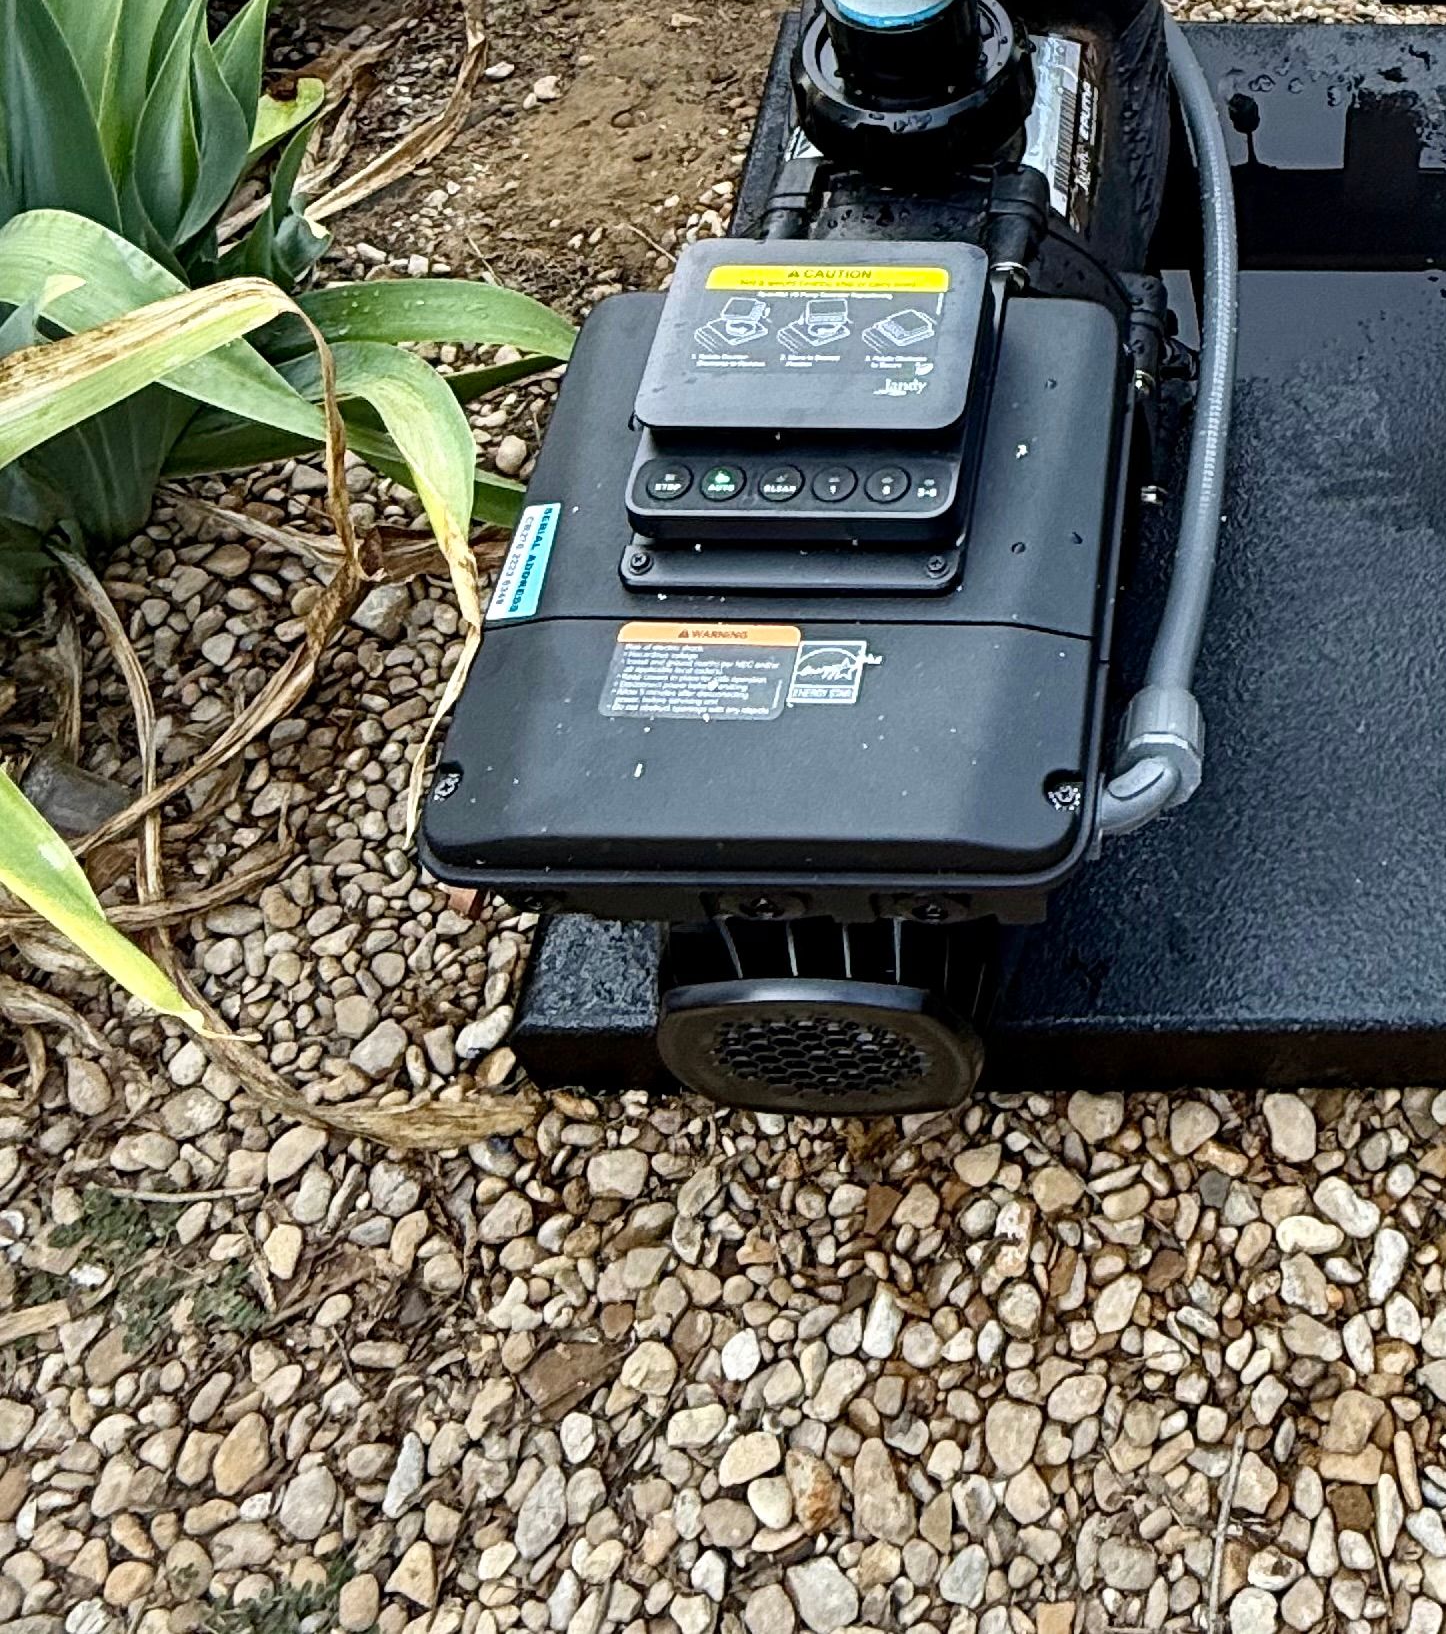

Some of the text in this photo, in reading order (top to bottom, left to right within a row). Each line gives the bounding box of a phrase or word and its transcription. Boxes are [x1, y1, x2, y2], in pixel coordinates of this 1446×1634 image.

[803, 269, 872, 279] CAUTION
[530, 507, 553, 551] SERIAL
[692, 629, 748, 639] WARNING
